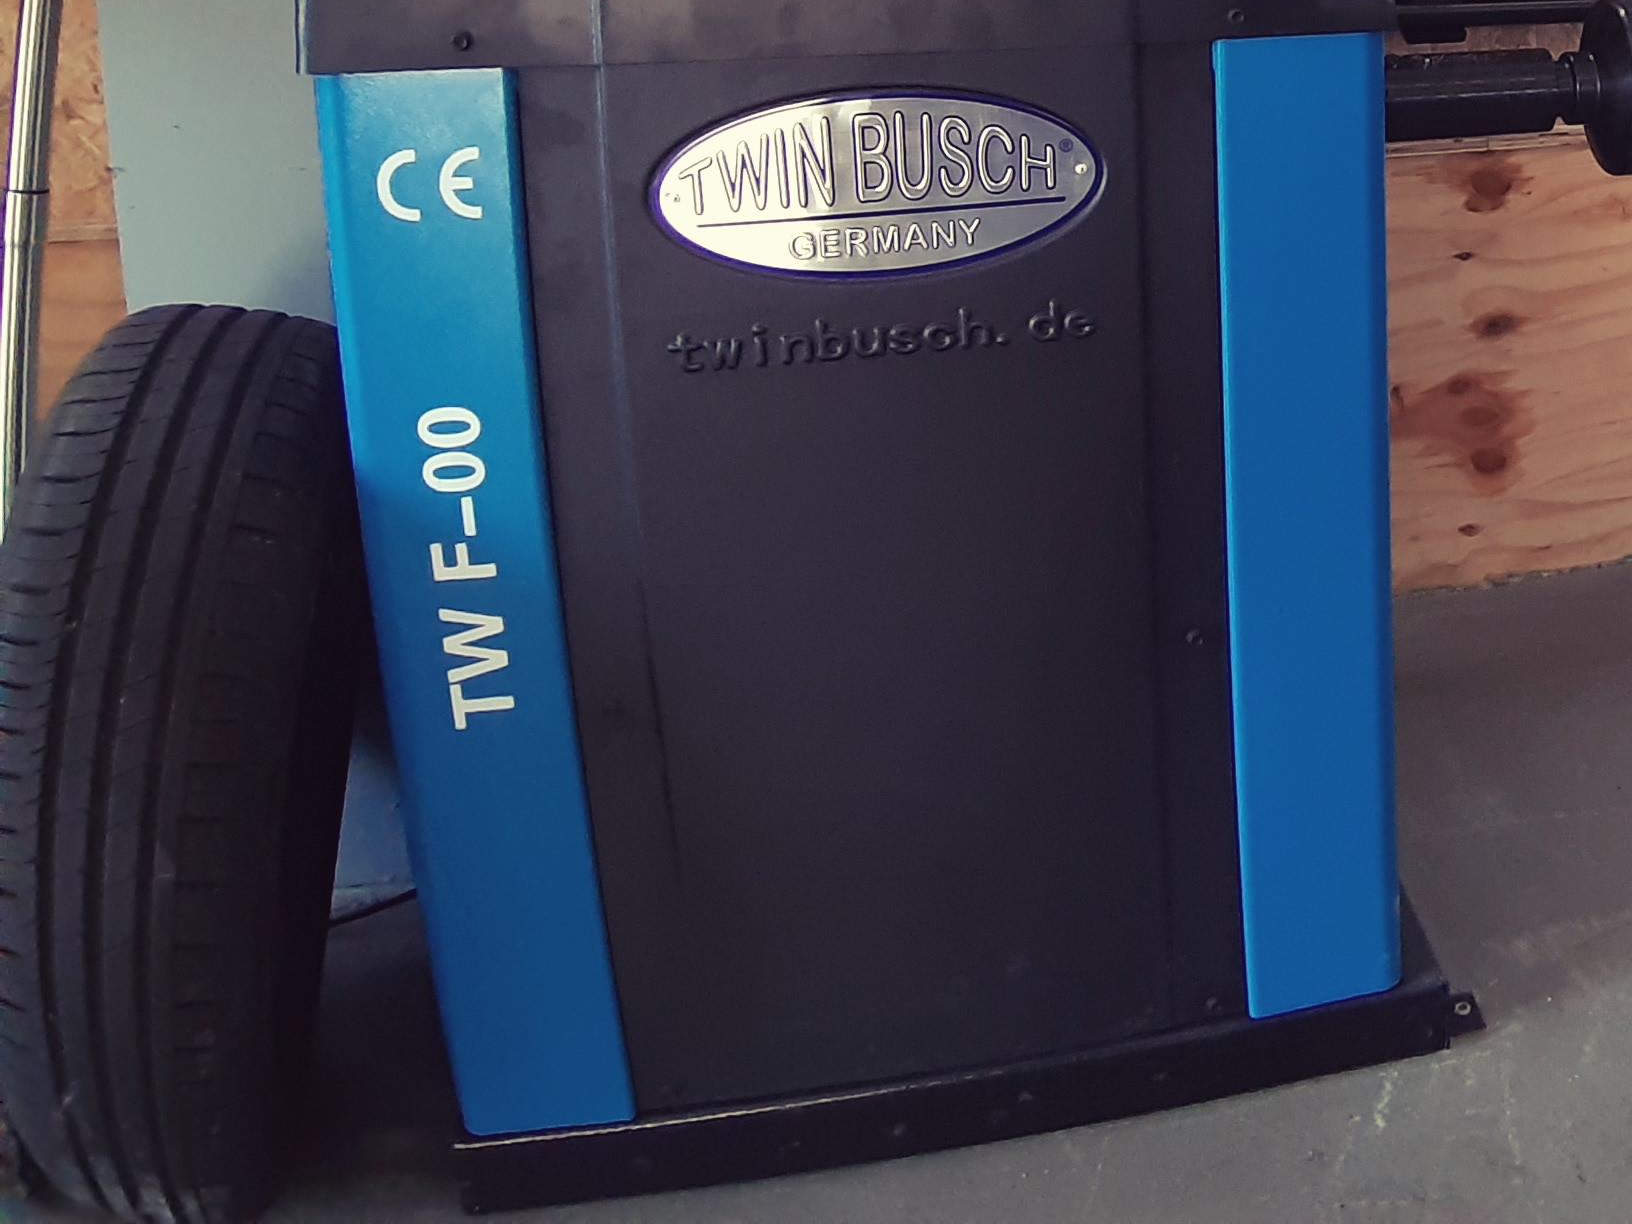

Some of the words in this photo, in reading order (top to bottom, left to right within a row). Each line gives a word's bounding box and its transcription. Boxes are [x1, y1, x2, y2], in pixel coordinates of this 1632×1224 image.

[376, 146, 483, 222] CE
[677, 114, 836, 216] TWIN
[788, 217, 982, 260] GERMANY
[415, 405, 498, 582] F-00
[437, 607, 516, 731] TW
